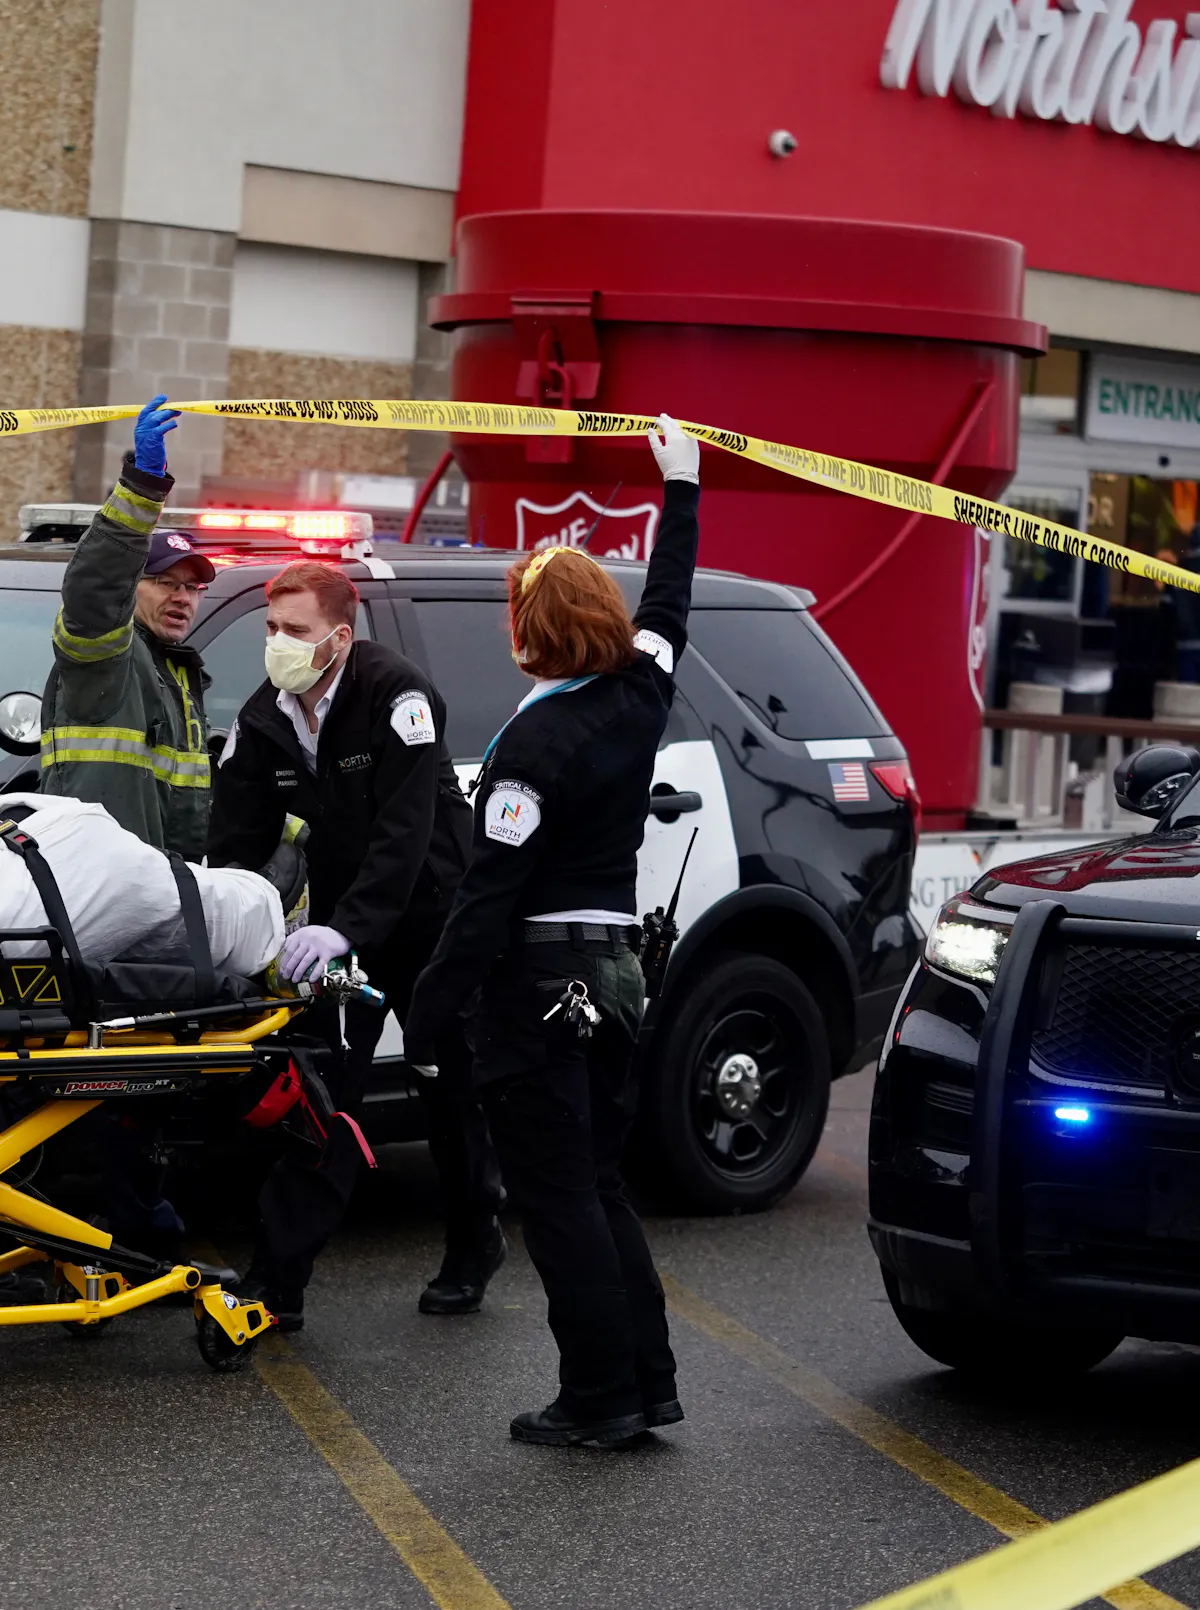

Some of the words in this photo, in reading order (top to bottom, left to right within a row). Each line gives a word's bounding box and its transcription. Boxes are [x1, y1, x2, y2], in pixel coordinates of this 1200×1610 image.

[296, 401, 314, 418] DO
[314, 401, 338, 420] NOT
[338, 401, 378, 422] CROSS
[386, 402, 445, 425] SHERIFF'S
[446, 404, 472, 426] LINE
[474, 406, 490, 428] DO
[492, 408, 515, 428] NOT
[518, 408, 556, 430] CROSS
[820, 456, 846, 485] LINE
[849, 463, 866, 491] DO
[869, 470, 891, 498] NOT
[894, 476, 932, 512] CROSS
[954, 496, 1011, 536] SHERIFF'S
[1013, 517, 1040, 544] LINE
[1063, 534, 1088, 559] NOT
[1090, 544, 1130, 572] CROSS
[406, 730, 433, 739] NORTH
[338, 752, 372, 768] NORTH
[495, 782, 522, 790] CRITICAL
[523, 786, 541, 802] CARE
[490, 824, 521, 839] NORTH
[64, 1080, 128, 1095] power
[126, 1082, 154, 1093] pro
